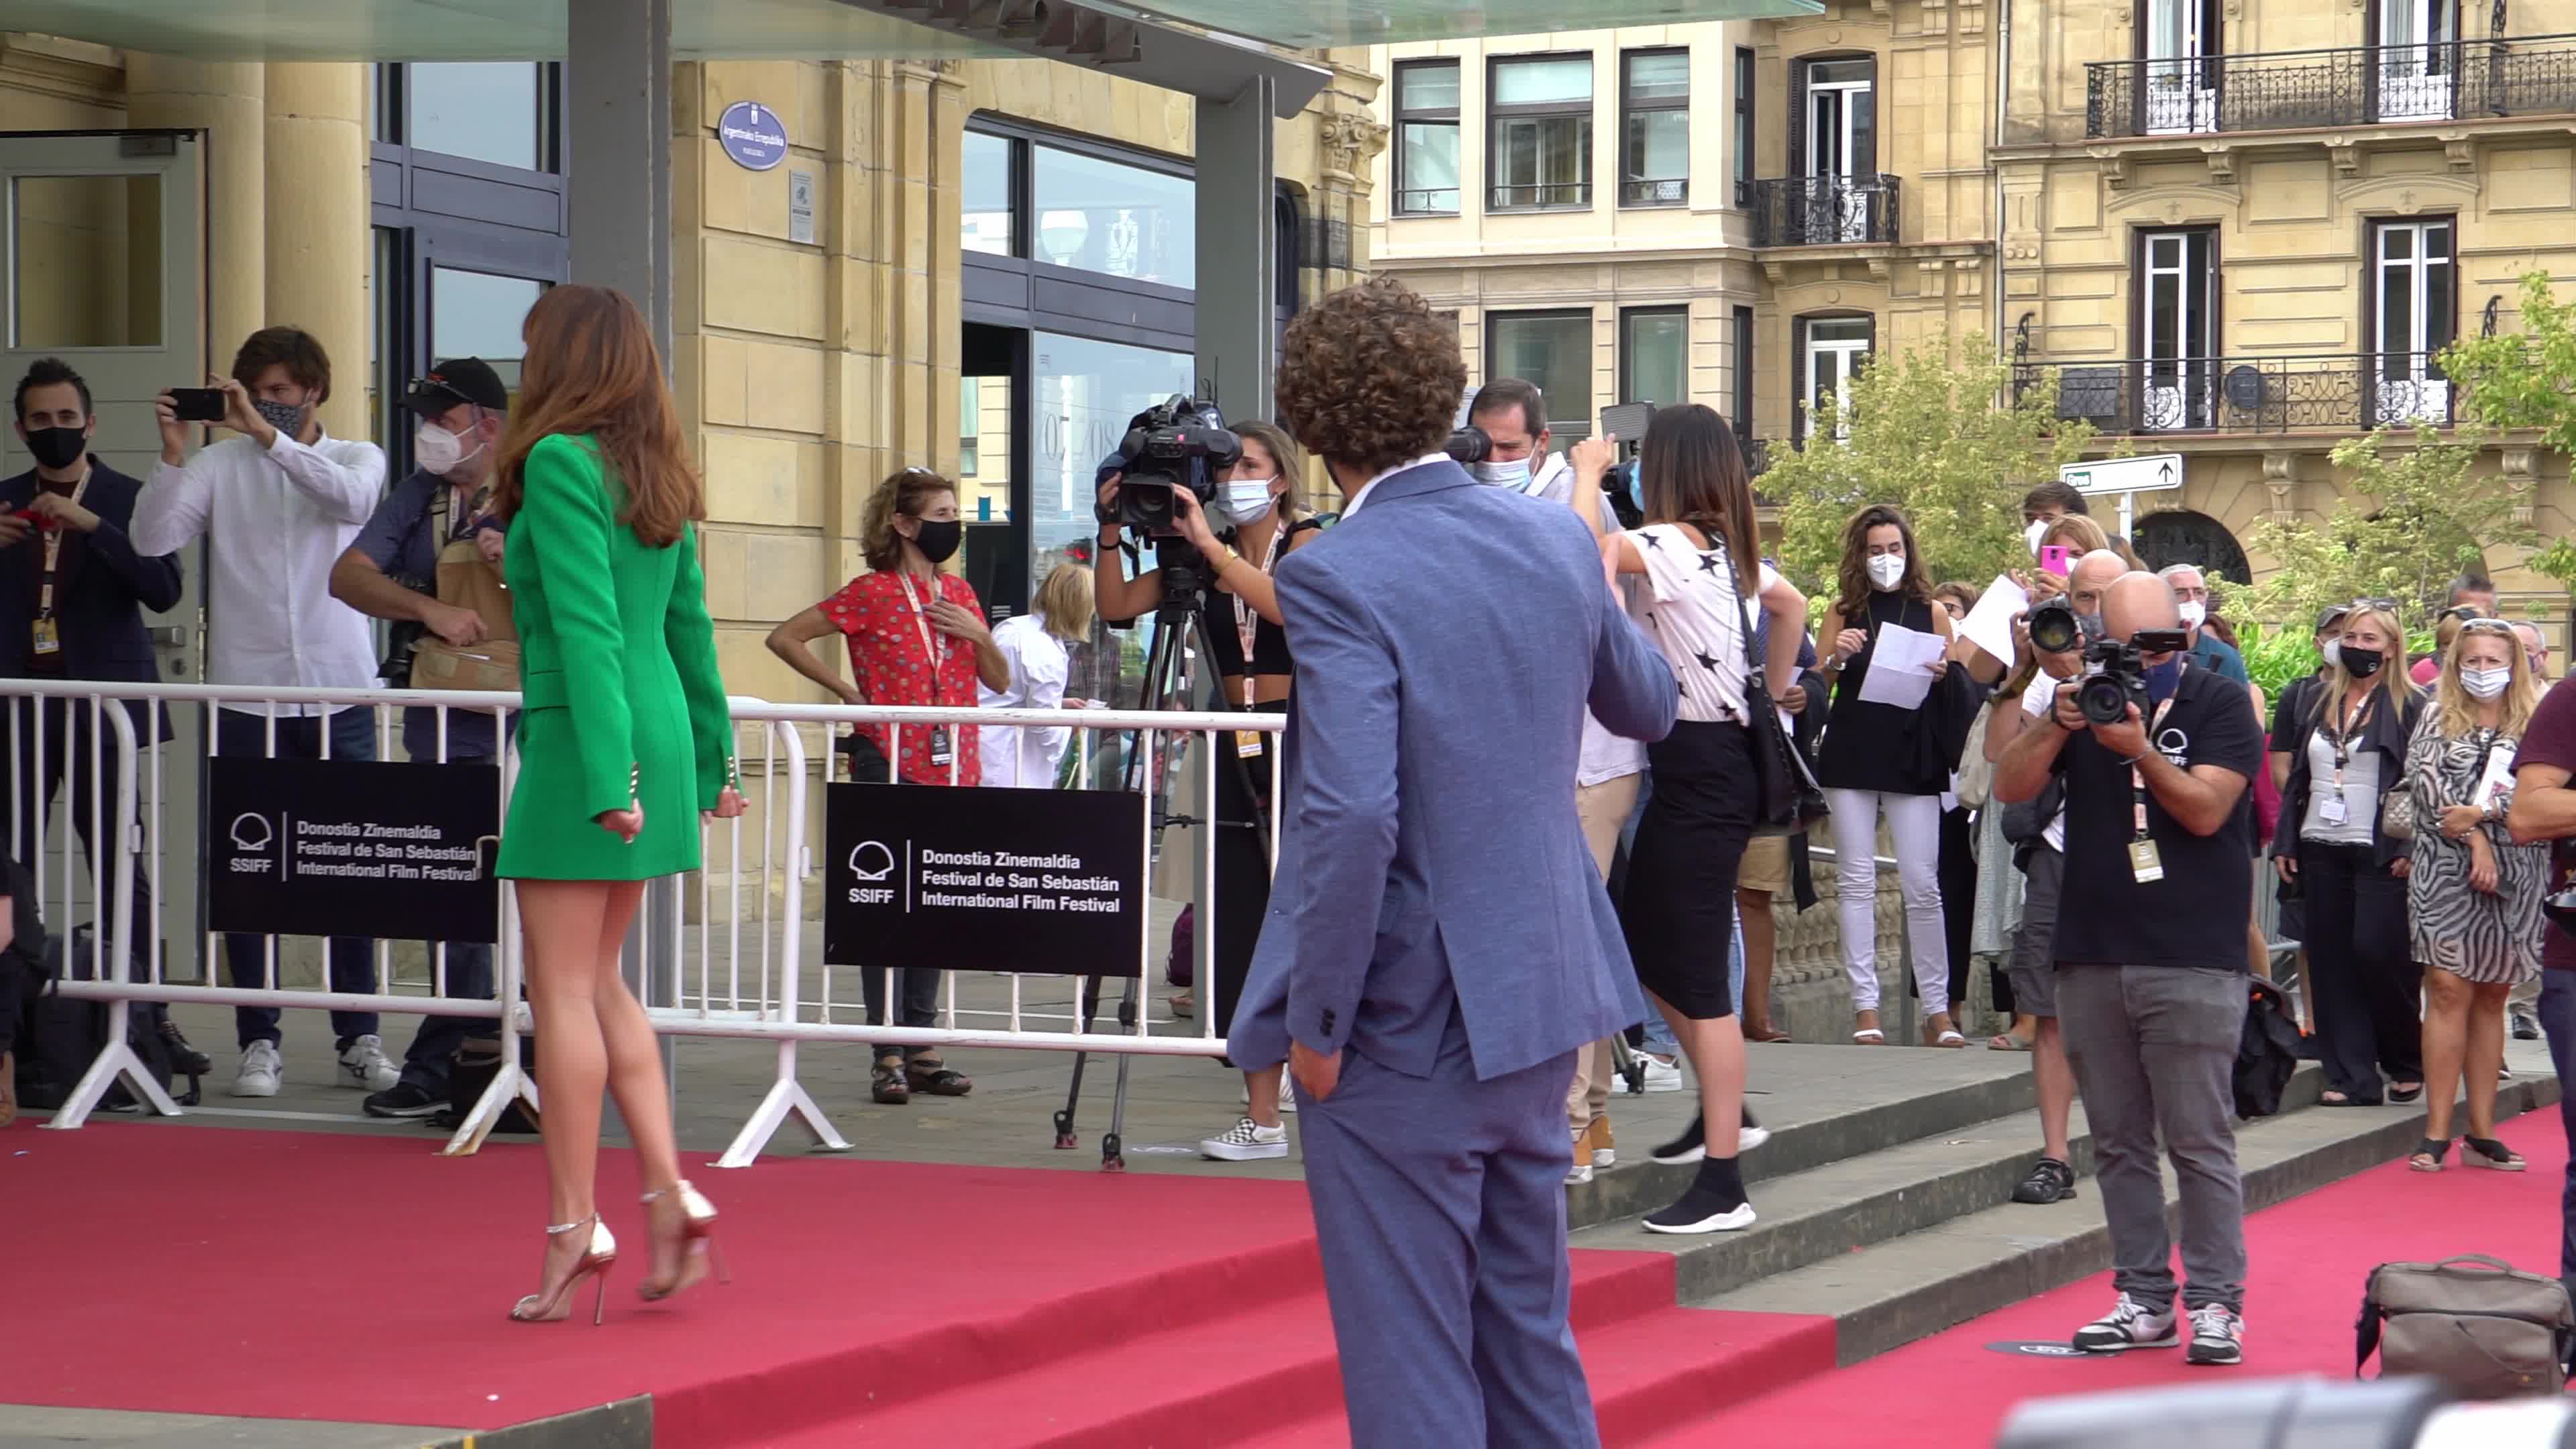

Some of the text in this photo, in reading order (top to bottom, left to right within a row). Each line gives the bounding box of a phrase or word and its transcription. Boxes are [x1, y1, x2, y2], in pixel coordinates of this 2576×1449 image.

[297, 820, 441, 840] Donostia Zinemaldia
[297, 840, 476, 861] Festival de San Sebastián
[922, 849, 1081, 869] Donostia Zinemaldia
[230, 857, 272, 873] SSIFF
[297, 860, 477, 881] International Film Festival
[922, 869, 1120, 892] Festival de San Sebastián
[849, 888, 894, 904] SSIFF
[922, 891, 1120, 912] International Film Festival
